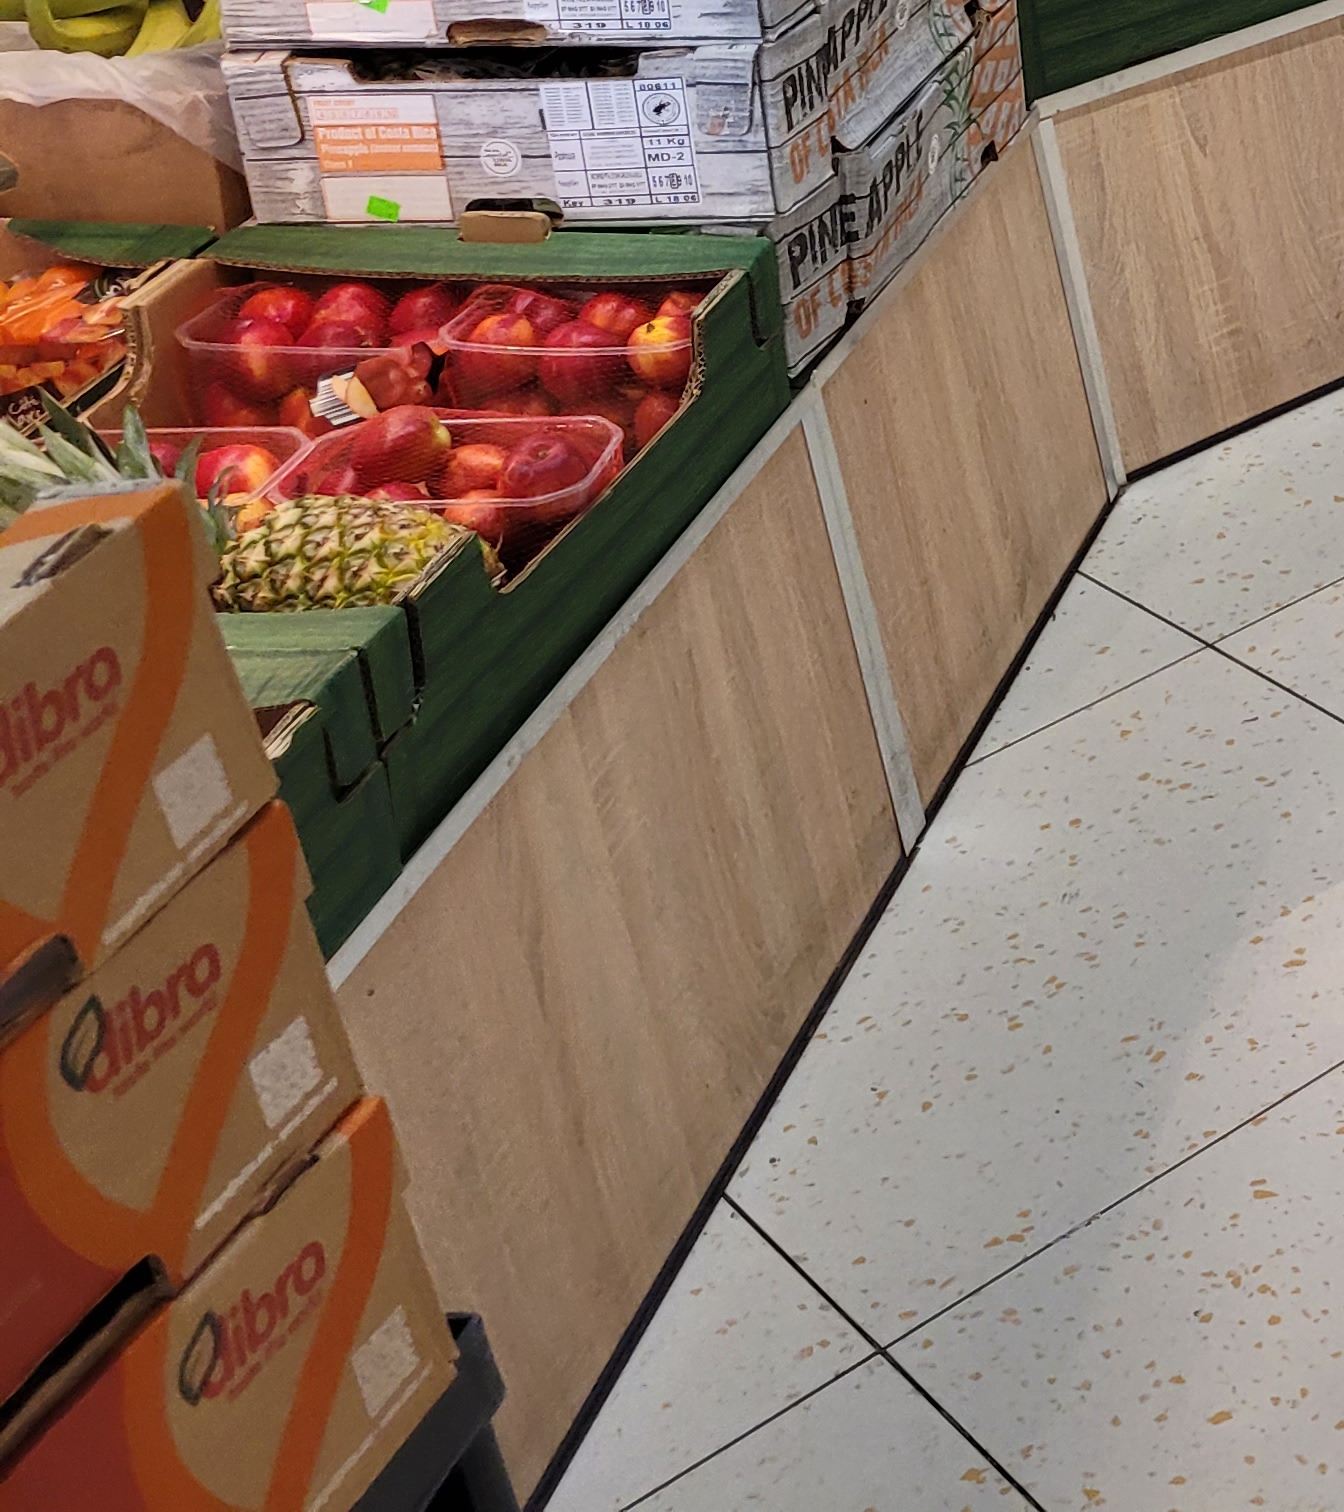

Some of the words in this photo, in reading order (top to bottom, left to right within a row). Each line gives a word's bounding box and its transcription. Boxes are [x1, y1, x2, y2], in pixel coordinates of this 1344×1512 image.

[318, 126, 362, 140] Product
[365, 126, 376, 139] of
[379, 125, 410, 139] Costa
[412, 125, 437, 139] Rica
[647, 152, 685, 162] MD-2
[790, 128, 812, 185] OF
[787, 107, 923, 290] PINEAPPLE
[793, 287, 822, 340] OF
[87, 942, 222, 1095] dibro
[202, 1239, 327, 1400] dibro
